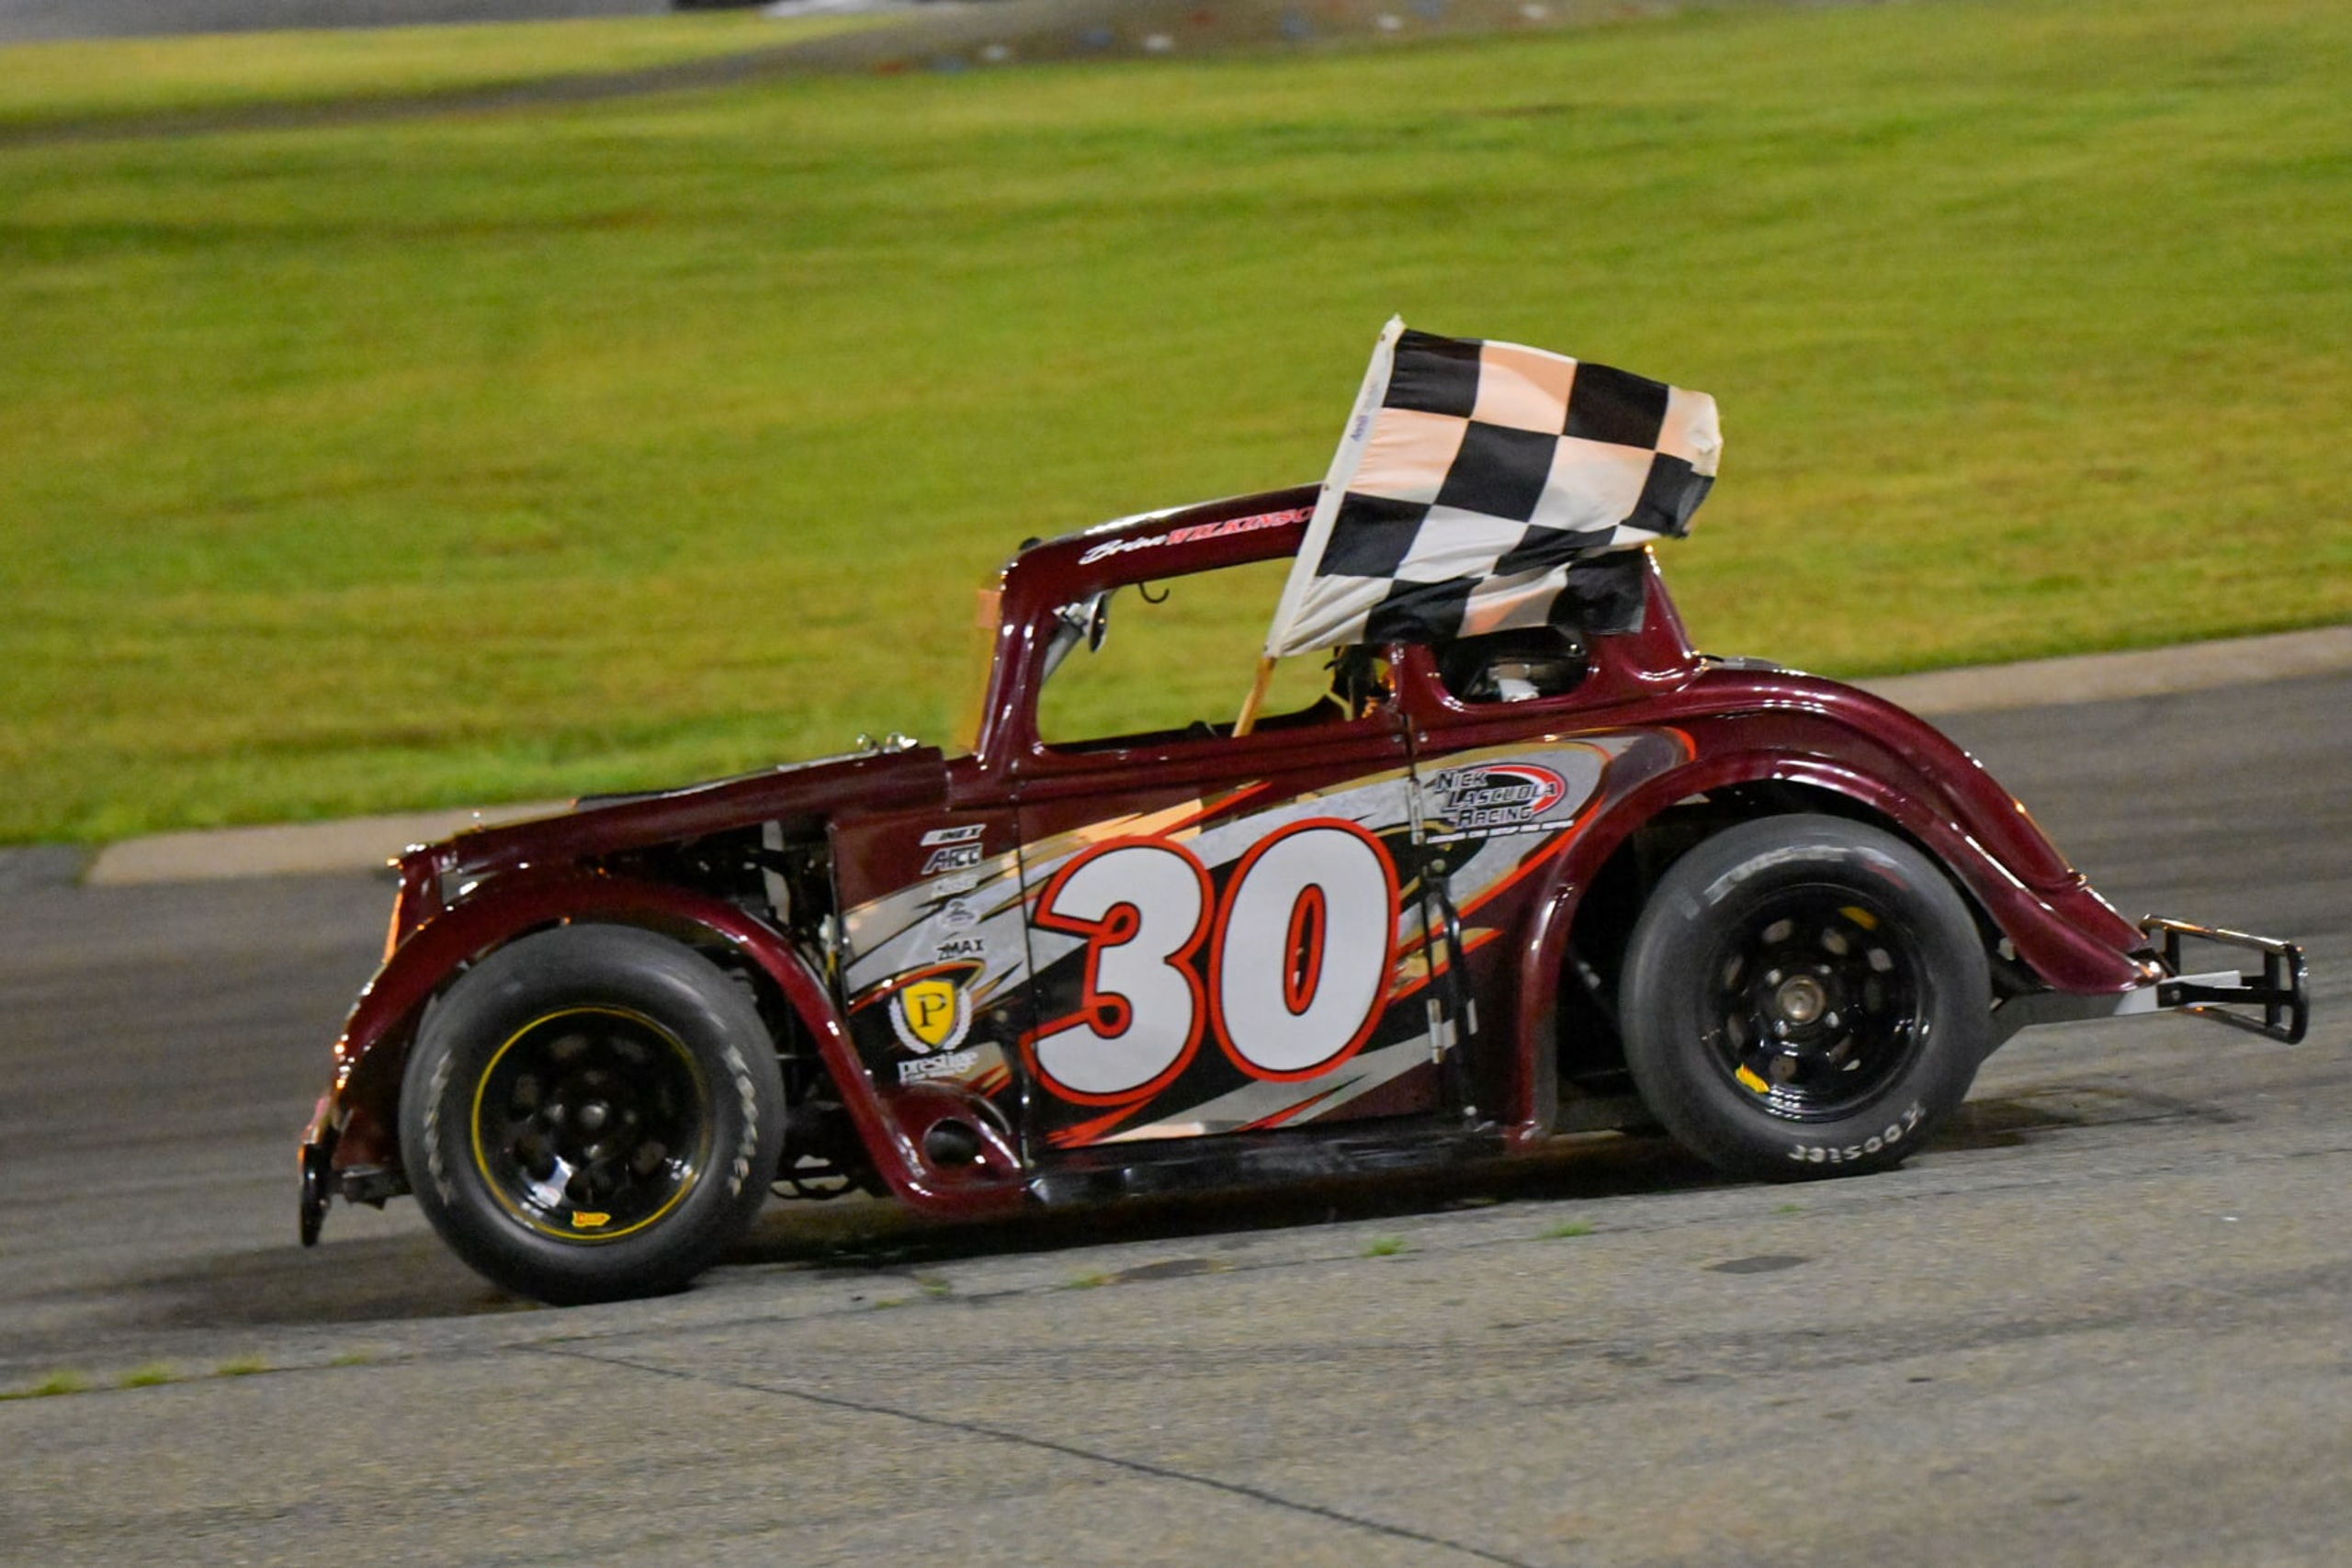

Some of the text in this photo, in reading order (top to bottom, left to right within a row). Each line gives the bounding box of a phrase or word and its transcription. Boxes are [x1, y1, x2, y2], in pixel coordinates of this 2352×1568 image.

[1456, 805, 1533, 828] RACING
[1022, 818, 1400, 1105] 30
[916, 992, 947, 1027] P
